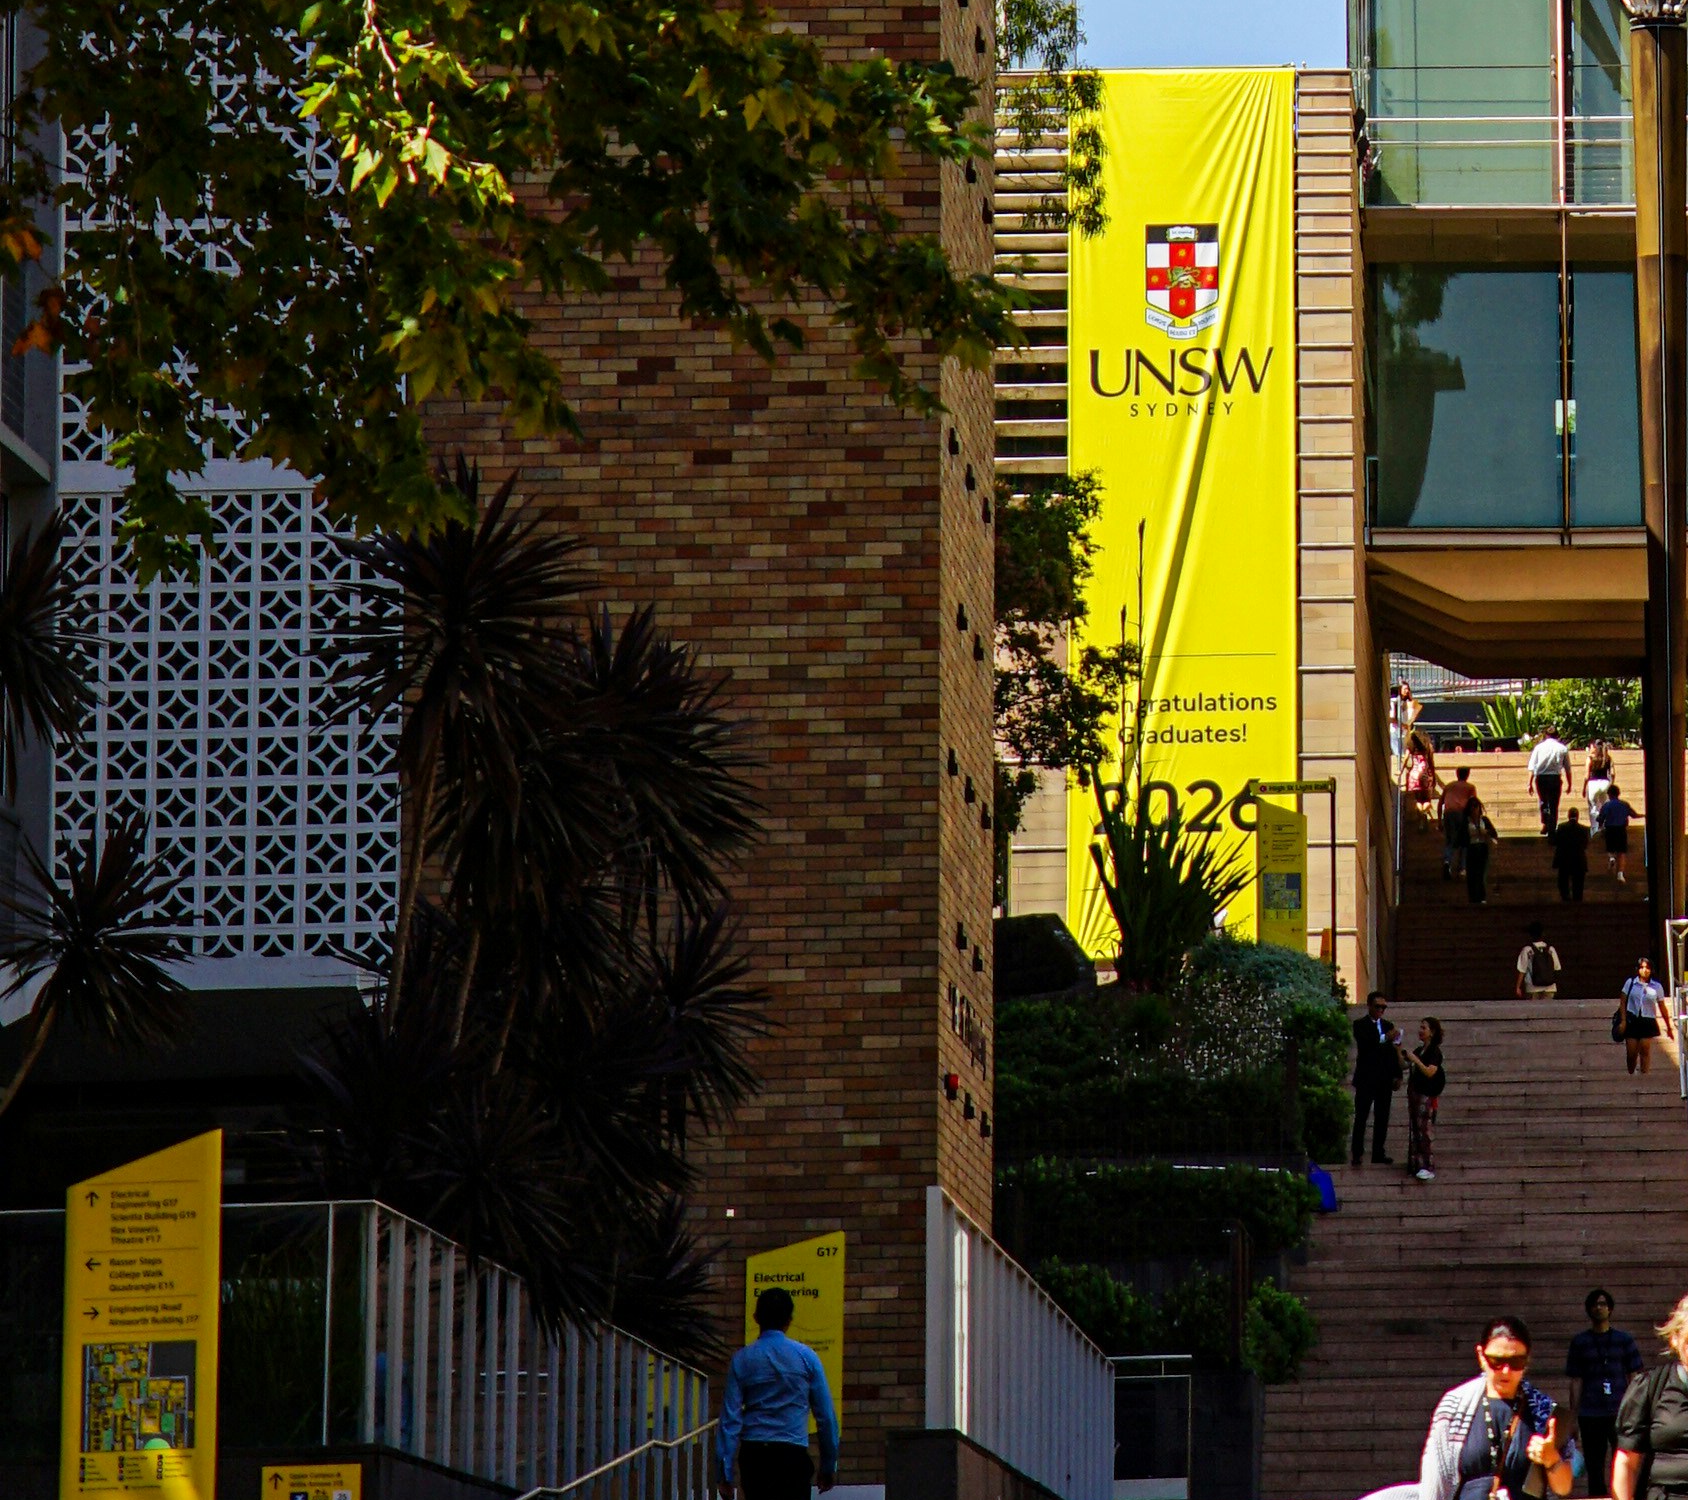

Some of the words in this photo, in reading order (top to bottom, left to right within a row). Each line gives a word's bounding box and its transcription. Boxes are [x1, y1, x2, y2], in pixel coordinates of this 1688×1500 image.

[1089, 346, 1274, 398] UNSW
[1130, 402, 1234, 418] SYDNEY
[1105, 692, 1277, 718] ngratulations
[110, 1190, 150, 1199] Electrical
[110, 1200, 161, 1210] Engineering
[144, 1211, 178, 1221] Building
[111, 1235, 144, 1245] Theatre
[816, 1247, 838, 1257] G17
[753, 1272, 805, 1283] Electrical
[753, 1286, 819, 1299] Eering
[109, 1304, 159, 1315] Engineering
[150, 1315, 183, 1326] Building
